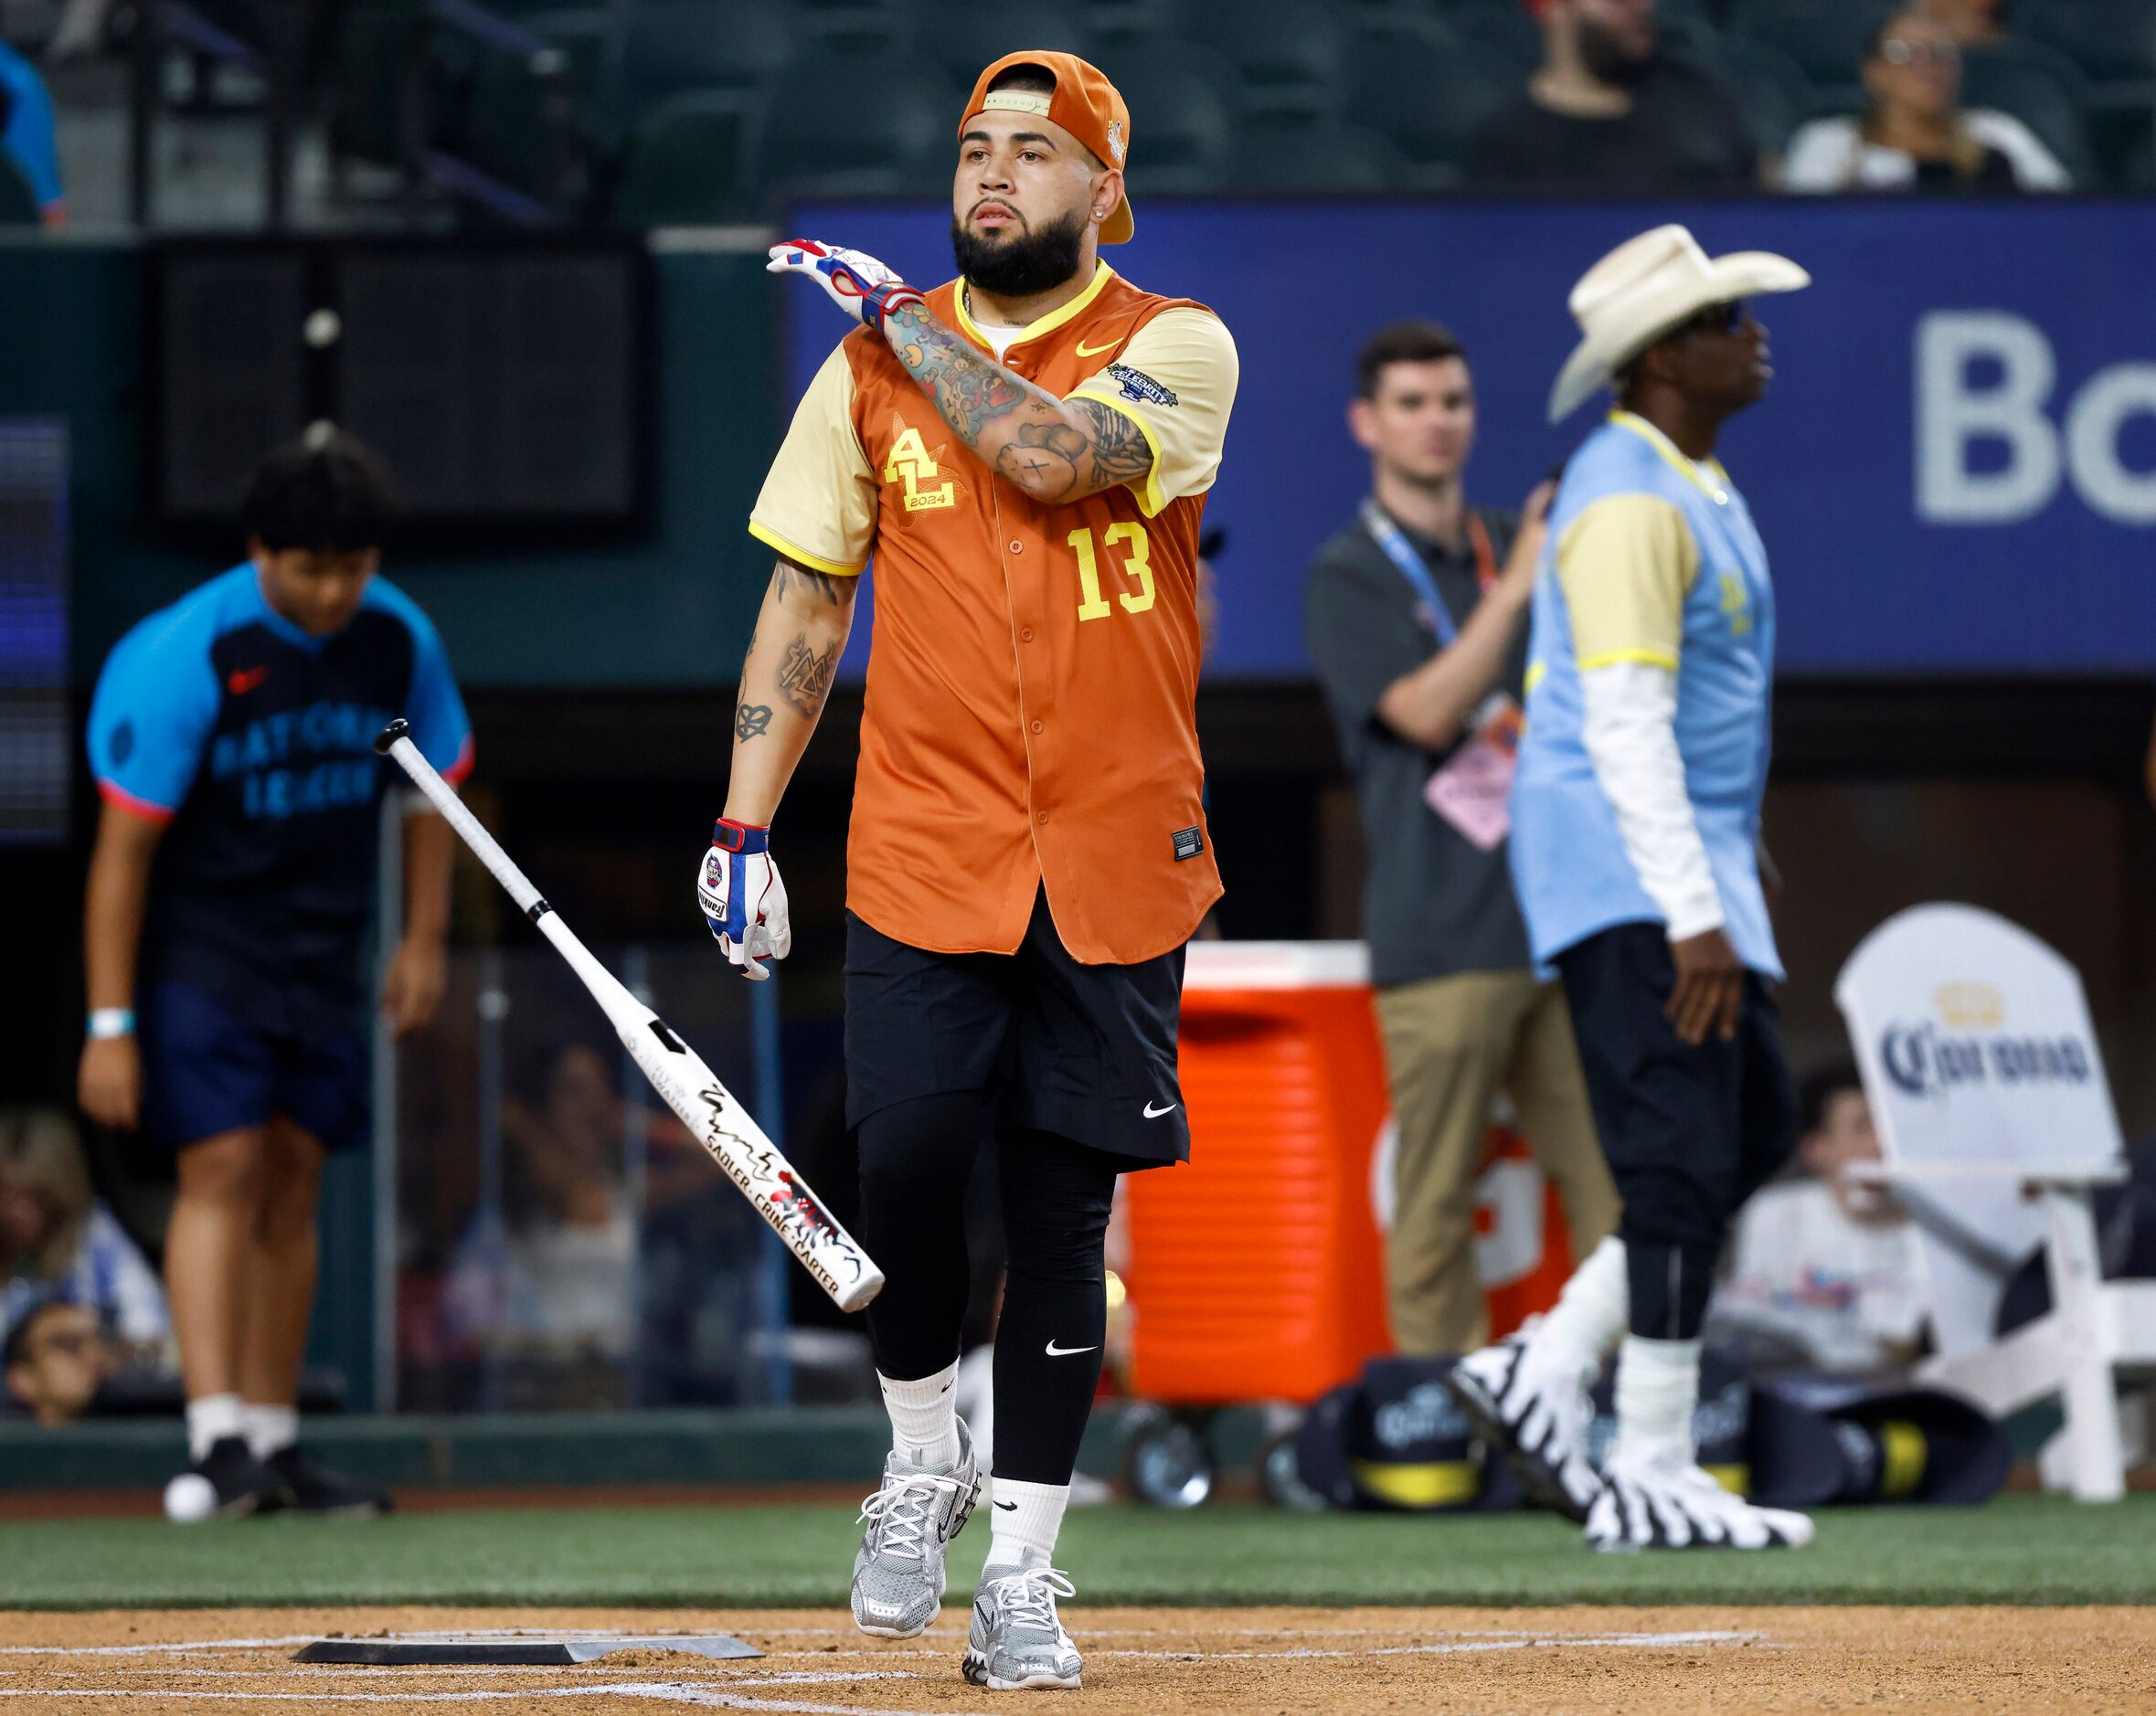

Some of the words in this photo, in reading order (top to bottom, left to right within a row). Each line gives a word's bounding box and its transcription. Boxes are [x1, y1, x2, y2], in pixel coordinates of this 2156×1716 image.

[1111, 370, 1167, 403] CELEBRITY
[884, 428, 955, 512] AL
[910, 494, 946, 507] 2024
[1067, 522, 1155, 621] 13
[1880, 1016, 2090, 1099] Corona
[706, 1135, 750, 1187] SADLER
[754, 1193, 791, 1234] CRINE
[794, 1240, 840, 1295] CARTER
